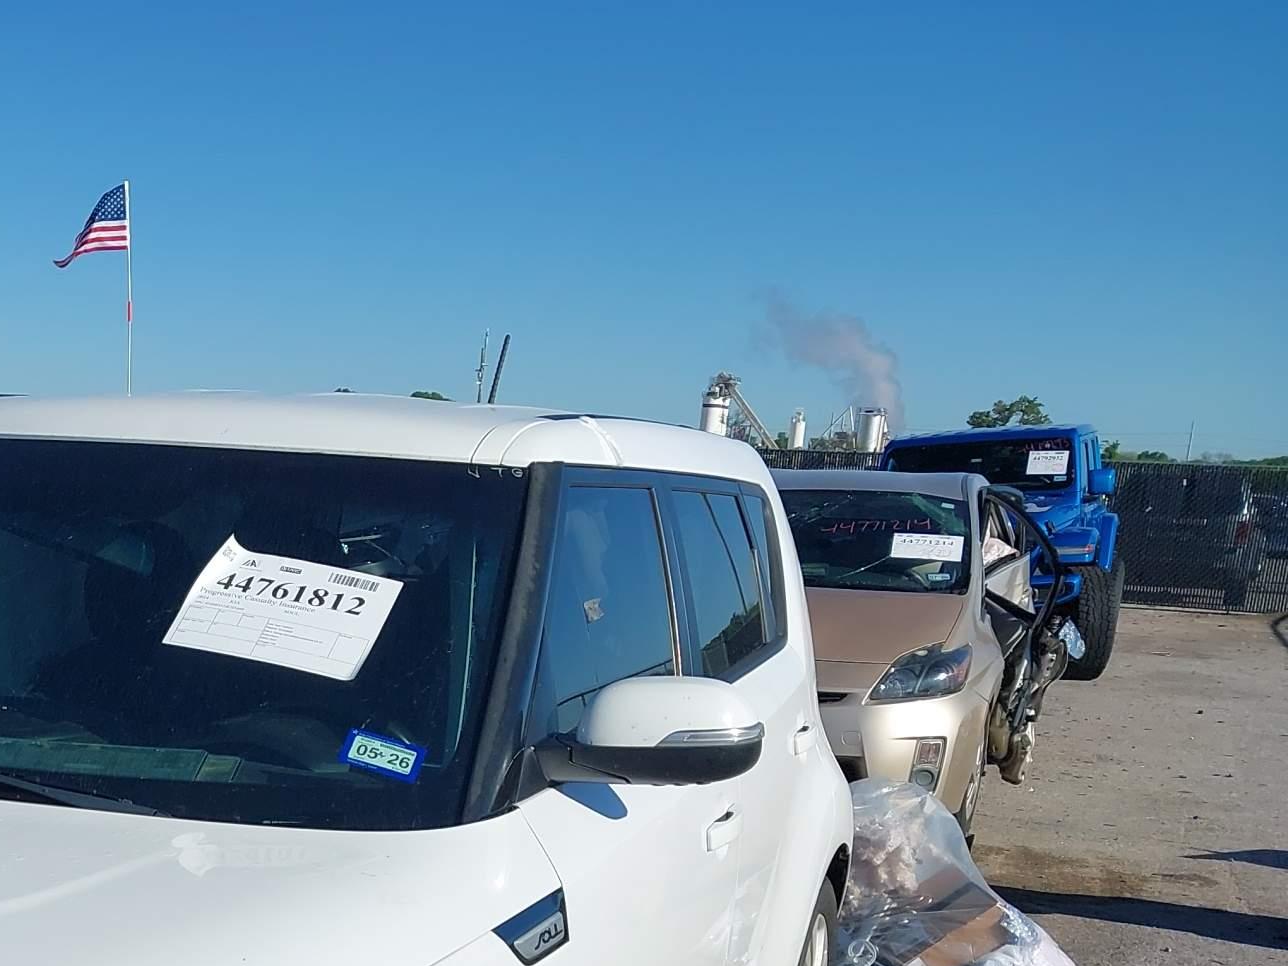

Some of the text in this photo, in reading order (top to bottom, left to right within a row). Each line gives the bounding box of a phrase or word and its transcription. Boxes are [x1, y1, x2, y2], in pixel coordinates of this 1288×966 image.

[216, 572, 366, 616] 44761812
[356, 744, 380, 759] 05
[386, 753, 411, 769] 26
